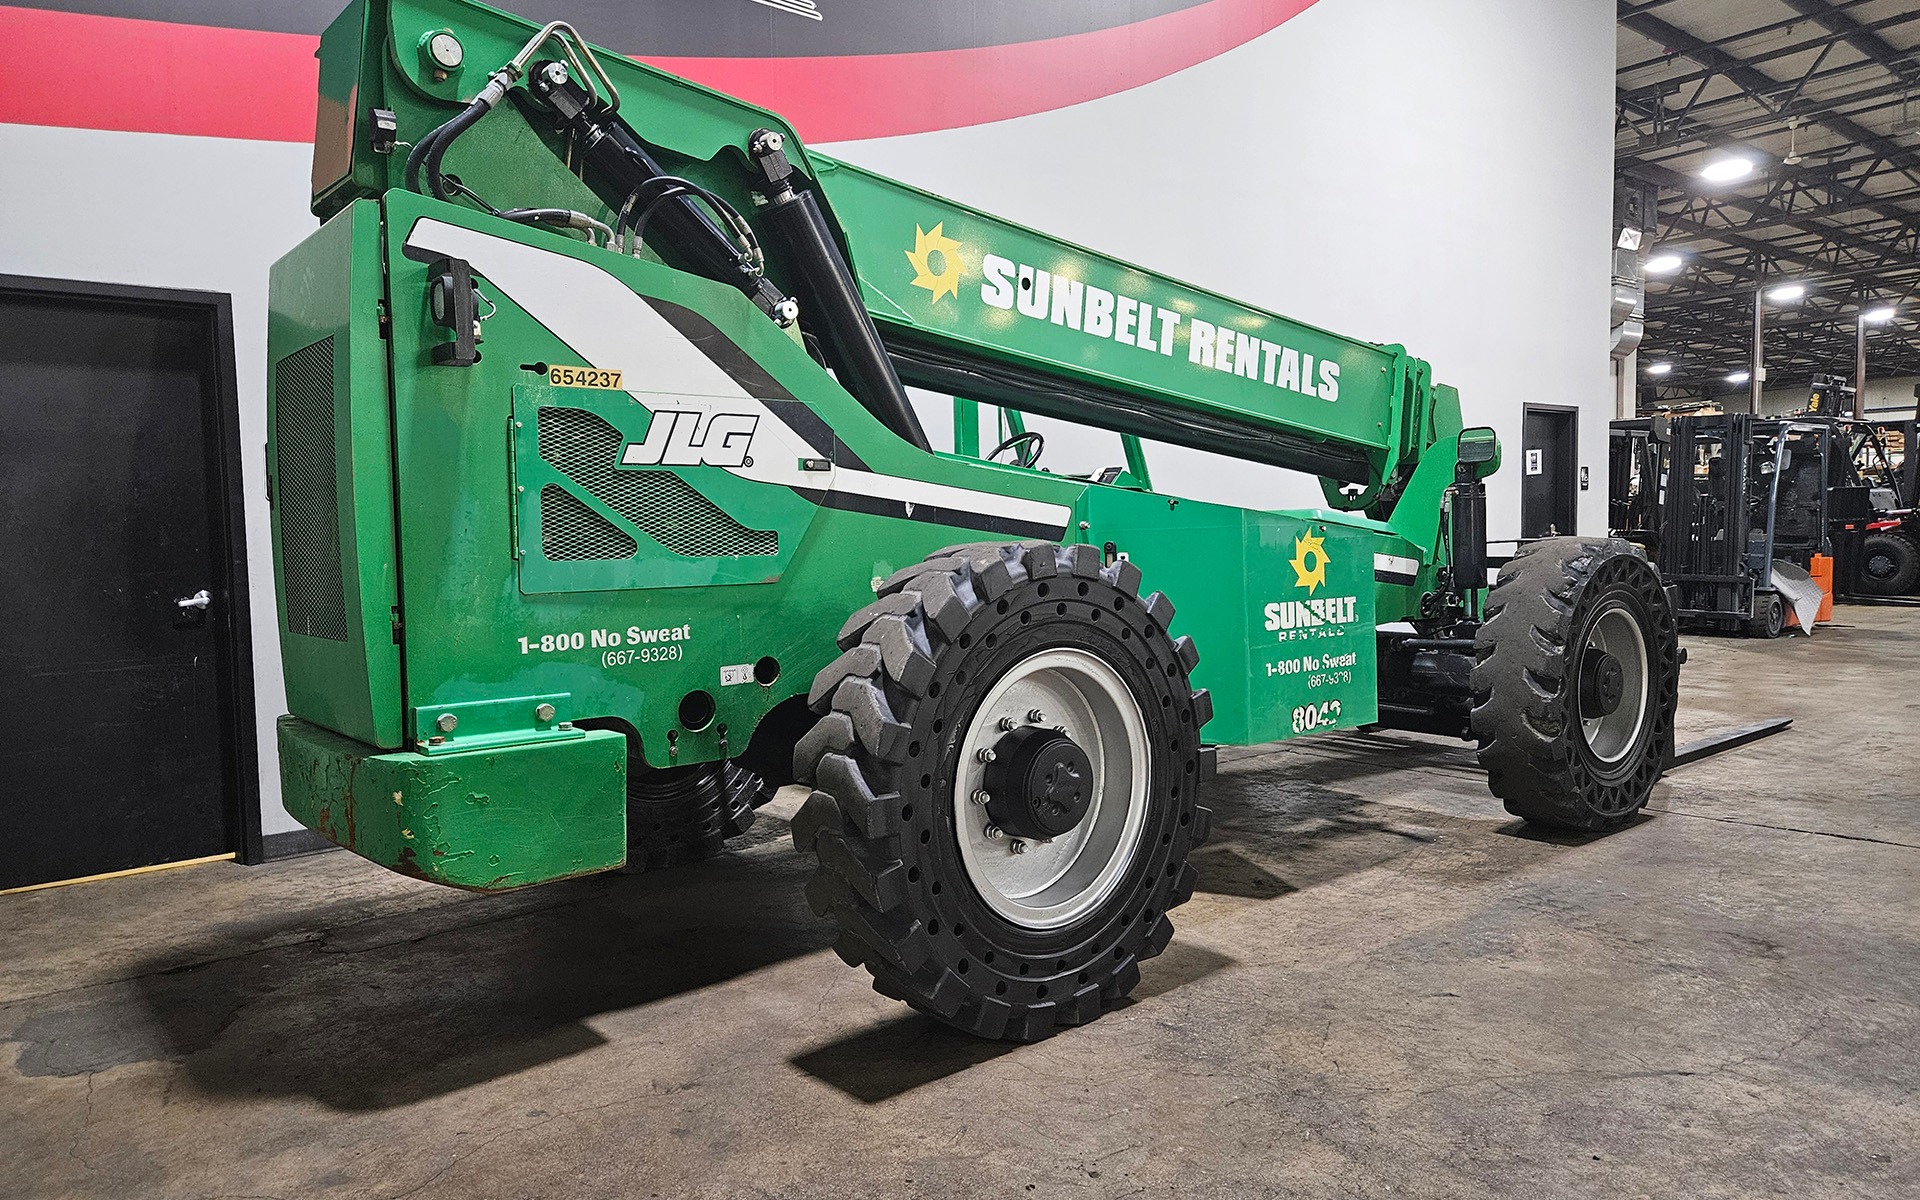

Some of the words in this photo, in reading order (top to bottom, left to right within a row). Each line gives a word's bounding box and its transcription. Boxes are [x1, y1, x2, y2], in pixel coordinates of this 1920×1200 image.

[980, 253, 1181, 357] SUNBELT
[1188, 317, 1341, 402] RENTALS
[550, 368, 622, 388] 654237
[619, 409, 760, 468] JLG
[1264, 596, 1357, 631] SUNBELT
[517, 631, 585, 655] 1-800
[590, 629, 621, 648] No
[626, 624, 691, 645] Sweat
[601, 644, 683, 669] (667-9328)
[1265, 658, 1301, 677] 1-800
[1303, 655, 1320, 672] No
[1322, 651, 1357, 669] Sweat
